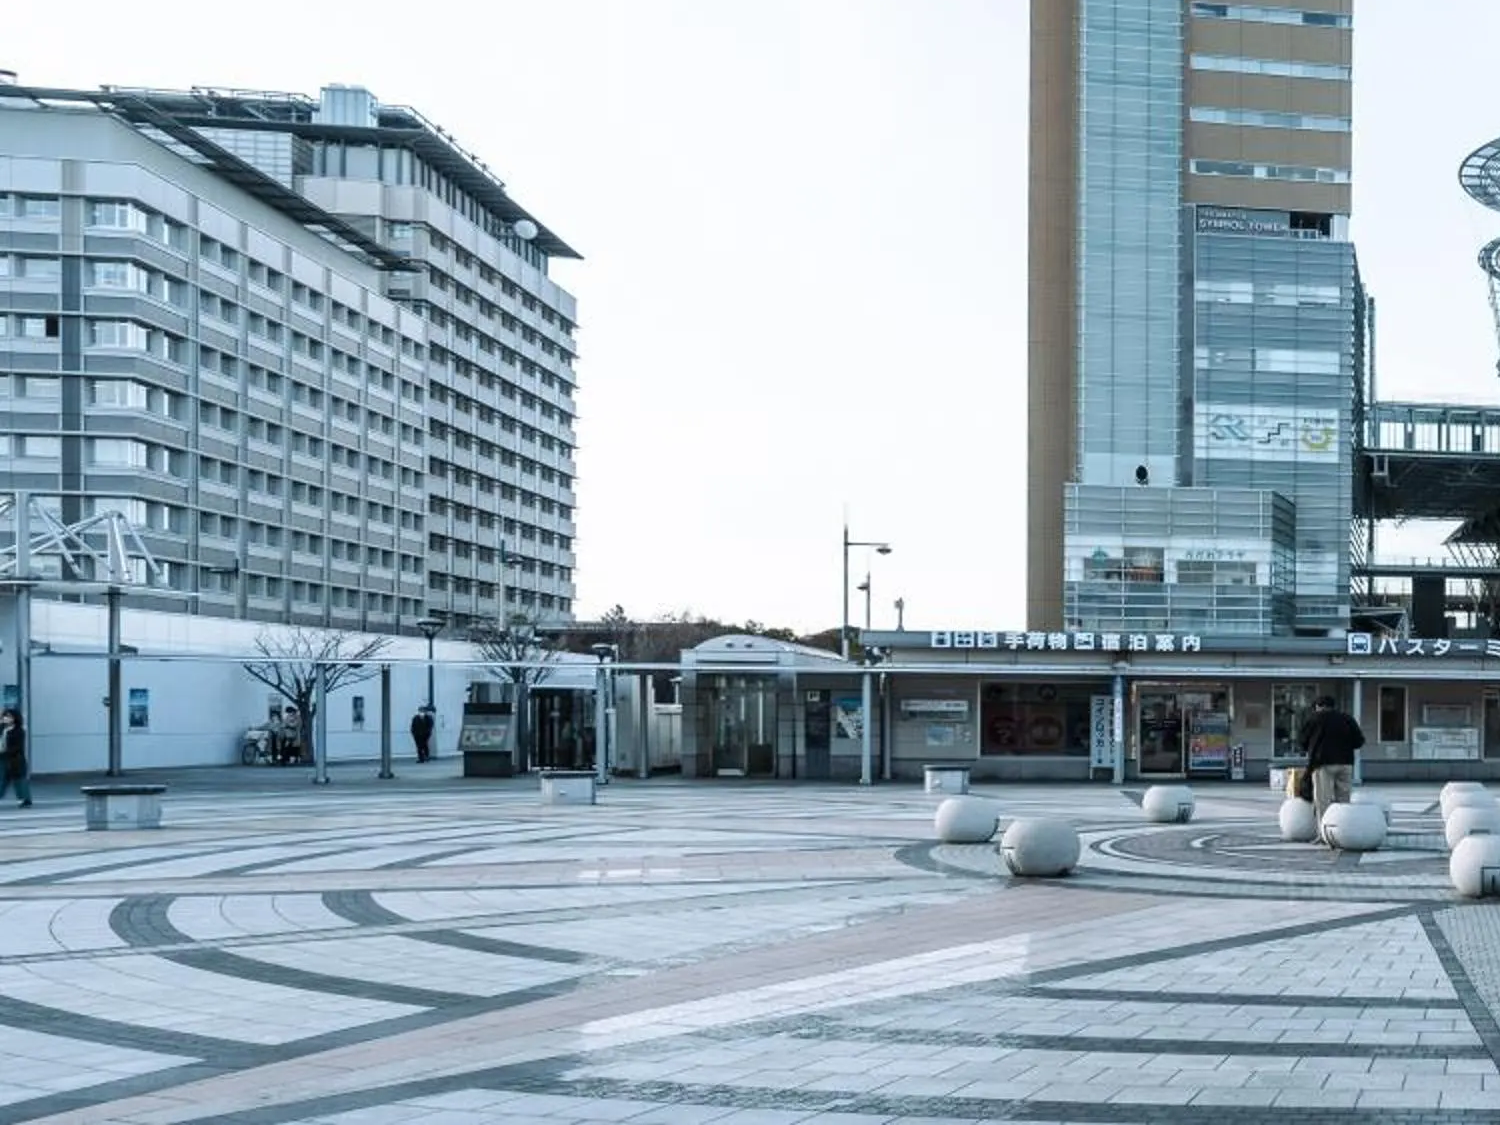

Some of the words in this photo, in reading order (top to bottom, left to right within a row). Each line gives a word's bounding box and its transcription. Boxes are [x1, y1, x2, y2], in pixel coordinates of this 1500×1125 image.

[1004, 631, 1068, 651] 手荷物
[1100, 633, 1201, 652] 宿泊案内
